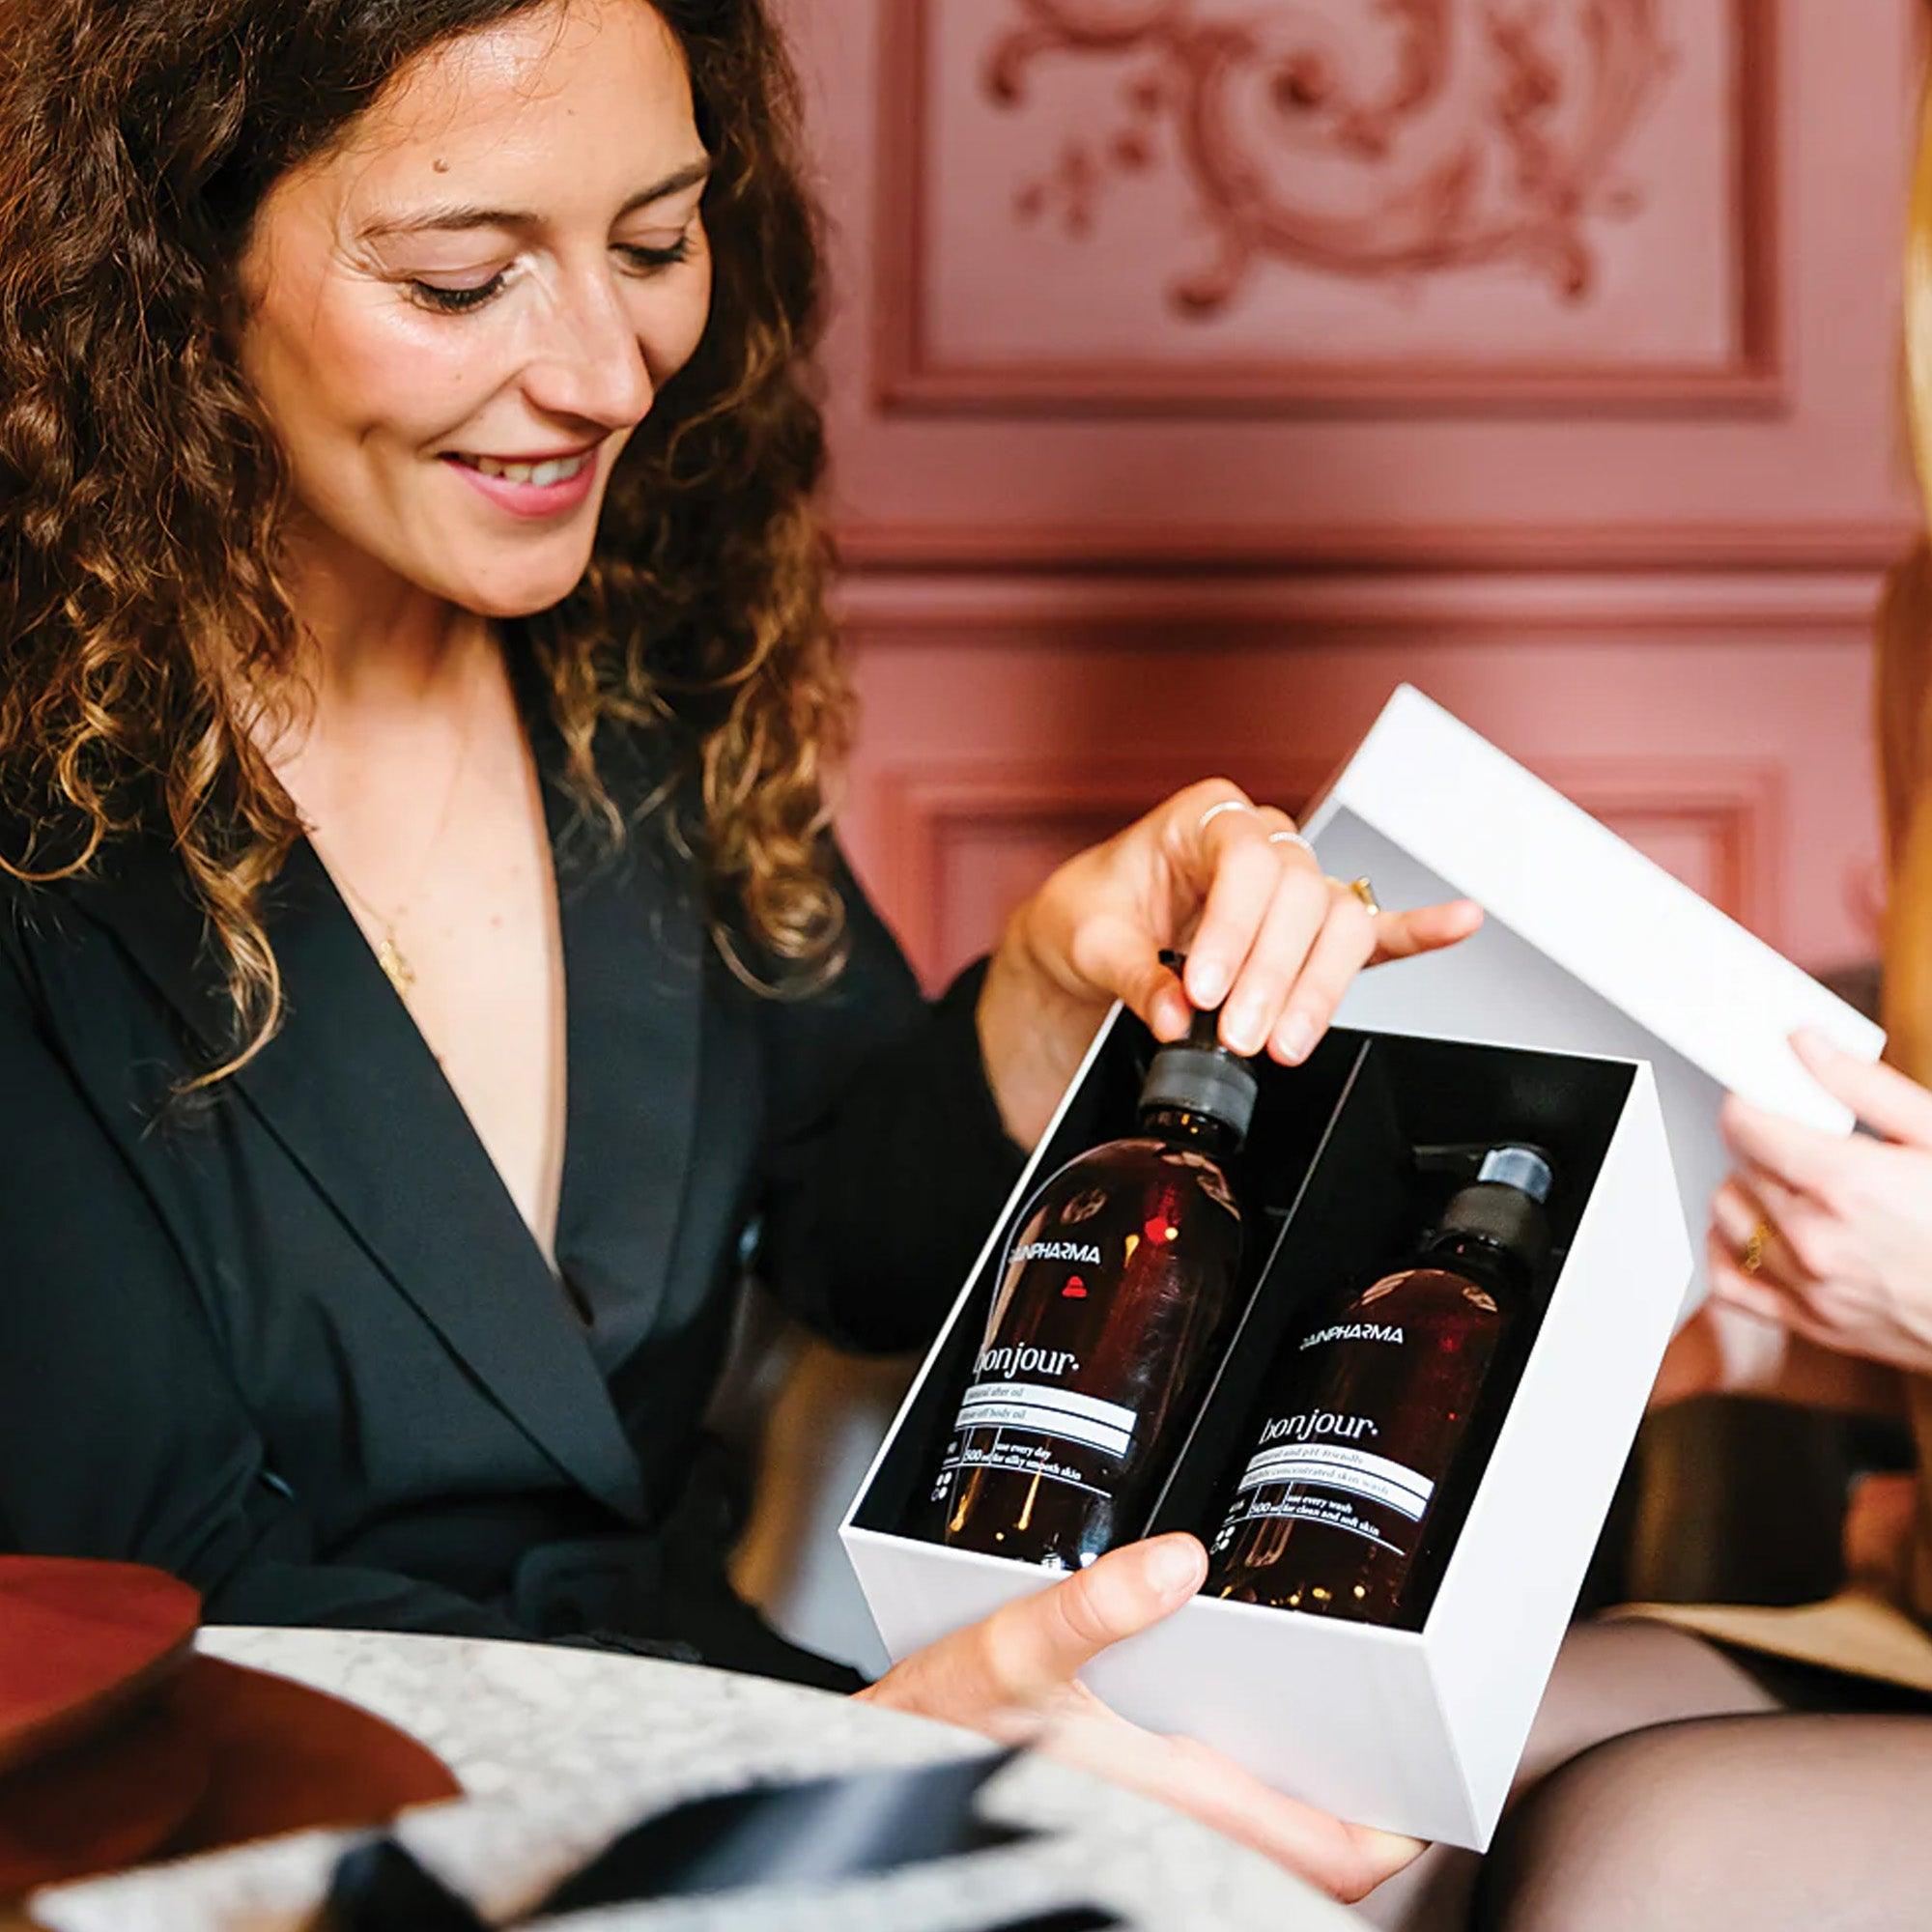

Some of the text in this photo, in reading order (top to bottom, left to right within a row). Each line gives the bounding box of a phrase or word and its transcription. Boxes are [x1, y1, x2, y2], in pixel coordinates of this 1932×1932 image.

[1258, 1408, 1378, 1445] bonjour.
[1034, 1446, 1052, 1460] day
[1359, 1520, 1380, 1537] skin
